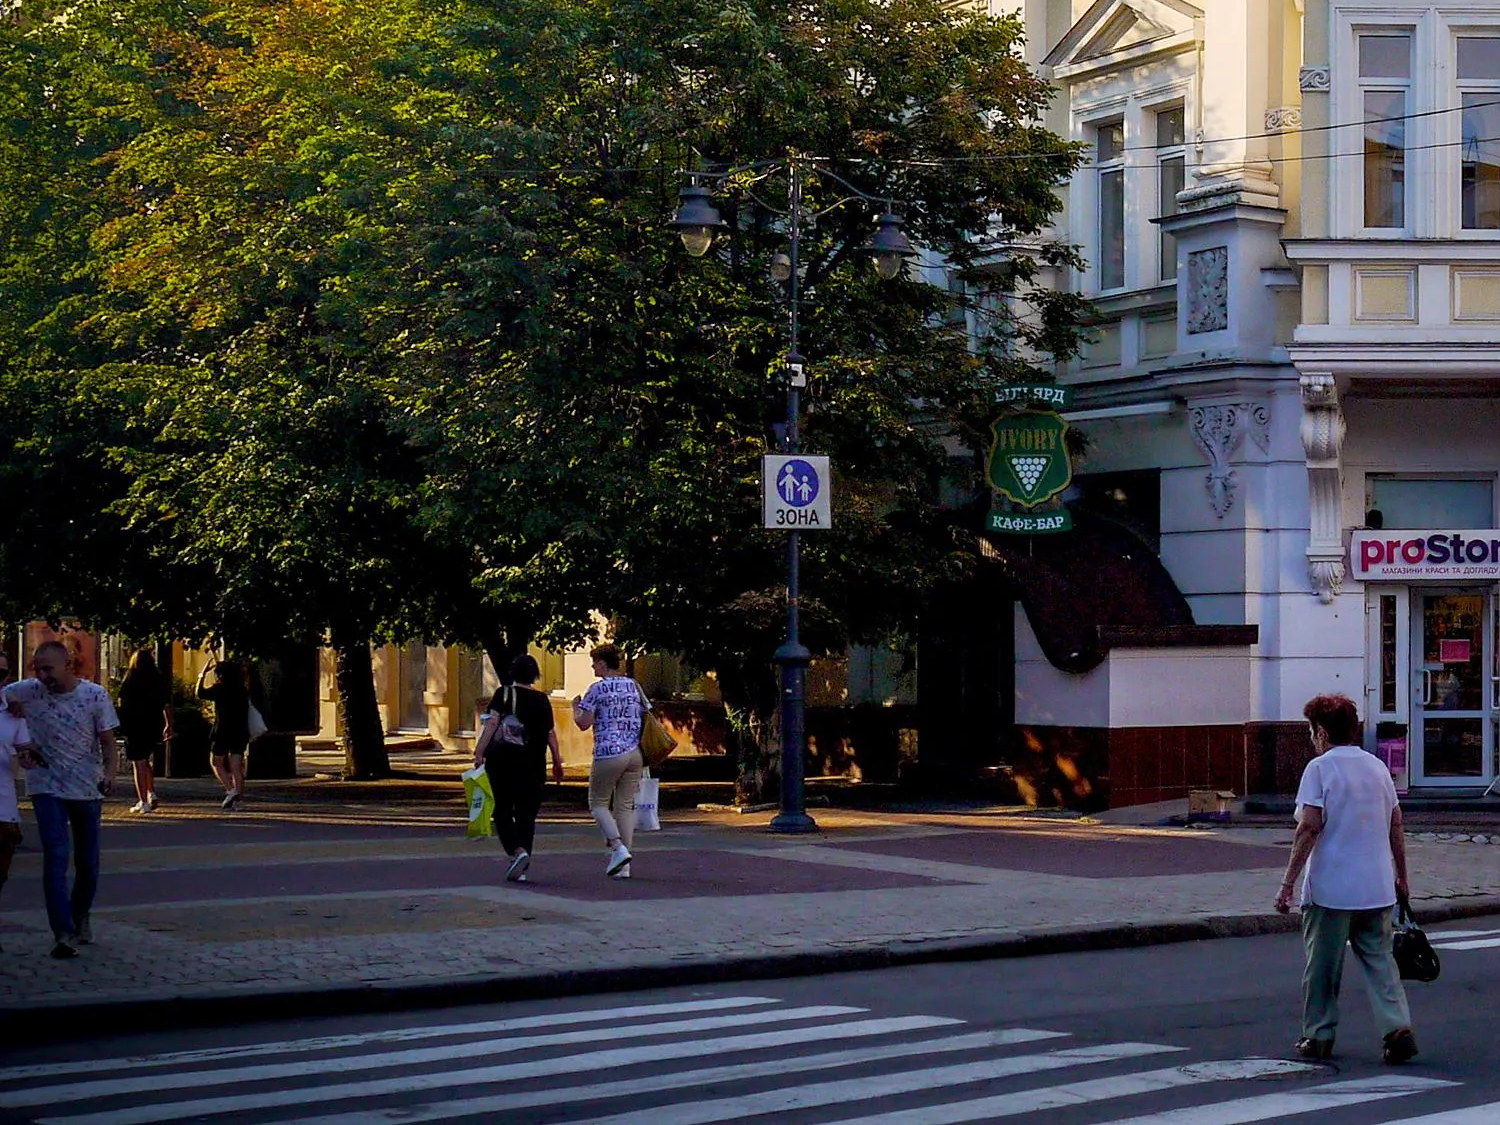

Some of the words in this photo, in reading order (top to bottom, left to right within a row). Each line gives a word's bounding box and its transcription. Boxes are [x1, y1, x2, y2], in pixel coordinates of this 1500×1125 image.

[1000, 428, 1058, 450] IVORY
[776, 508, 820, 526] ЗОНА
[992, 516, 1064, 530] КАФЕ-БАР
[1382, 566, 1423, 575] МАГАЗИНИ
[1426, 566, 1449, 575] КРАСИ
[1452, 566, 1461, 575] ТА
[1463, 566, 1499, 575] ДОГЛЯДУ
